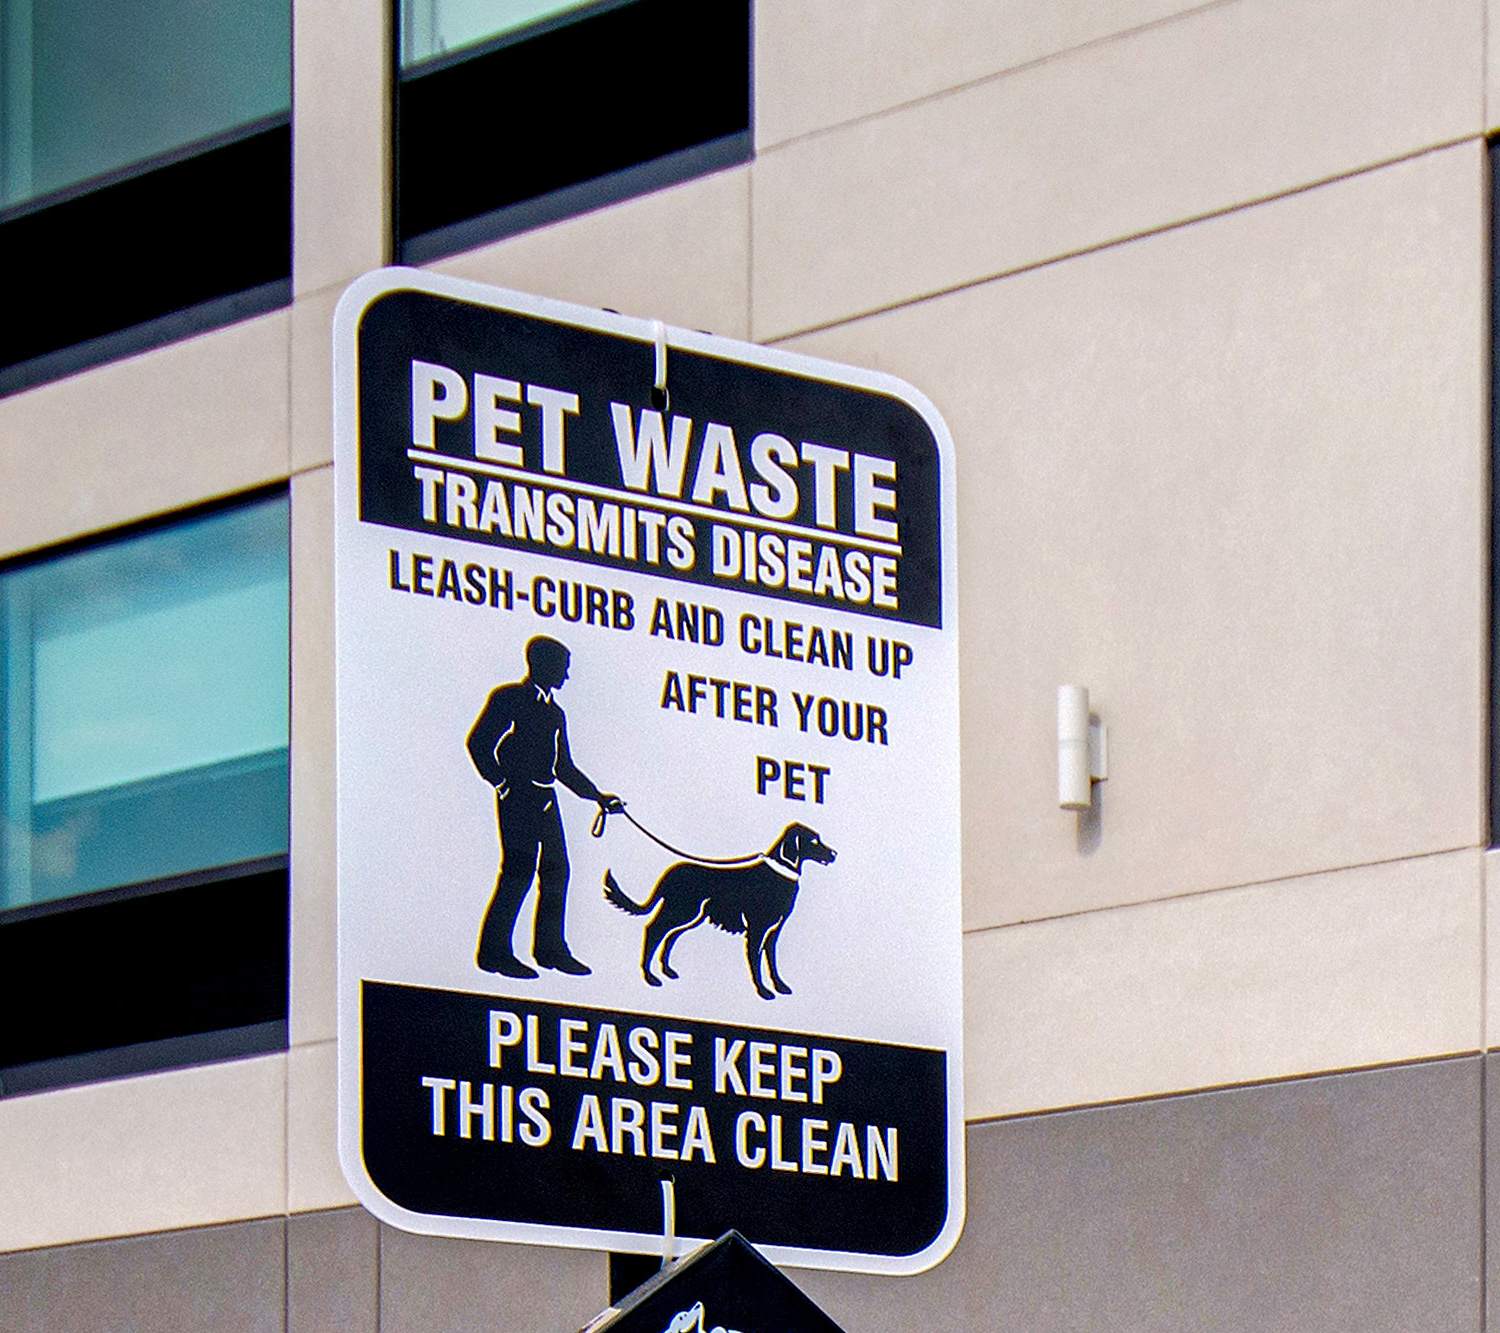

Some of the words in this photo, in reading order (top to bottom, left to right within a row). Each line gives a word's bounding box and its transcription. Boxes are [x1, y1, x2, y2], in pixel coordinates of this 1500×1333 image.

[411, 359, 579, 475] PET
[610, 401, 899, 541] WASTE
[413, 465, 696, 570] TRANSMITS
[712, 524, 899, 610] DISEASE
[388, 549, 635, 631] LEASH-CURB
[650, 598, 725, 648] AND
[740, 614, 854, 671] CLEAN
[867, 636, 914, 679] UP
[660, 670, 779, 728] AFTER
[793, 691, 889, 747] YOUR
[756, 755, 831, 805] PET
[487, 1009, 693, 1089] PLEASE
[714, 1037, 843, 1104] KEEP
[421, 1076, 552, 1147] THIS
[571, 1094, 717, 1164] AREA
[735, 1111, 899, 1183] CLEAN
